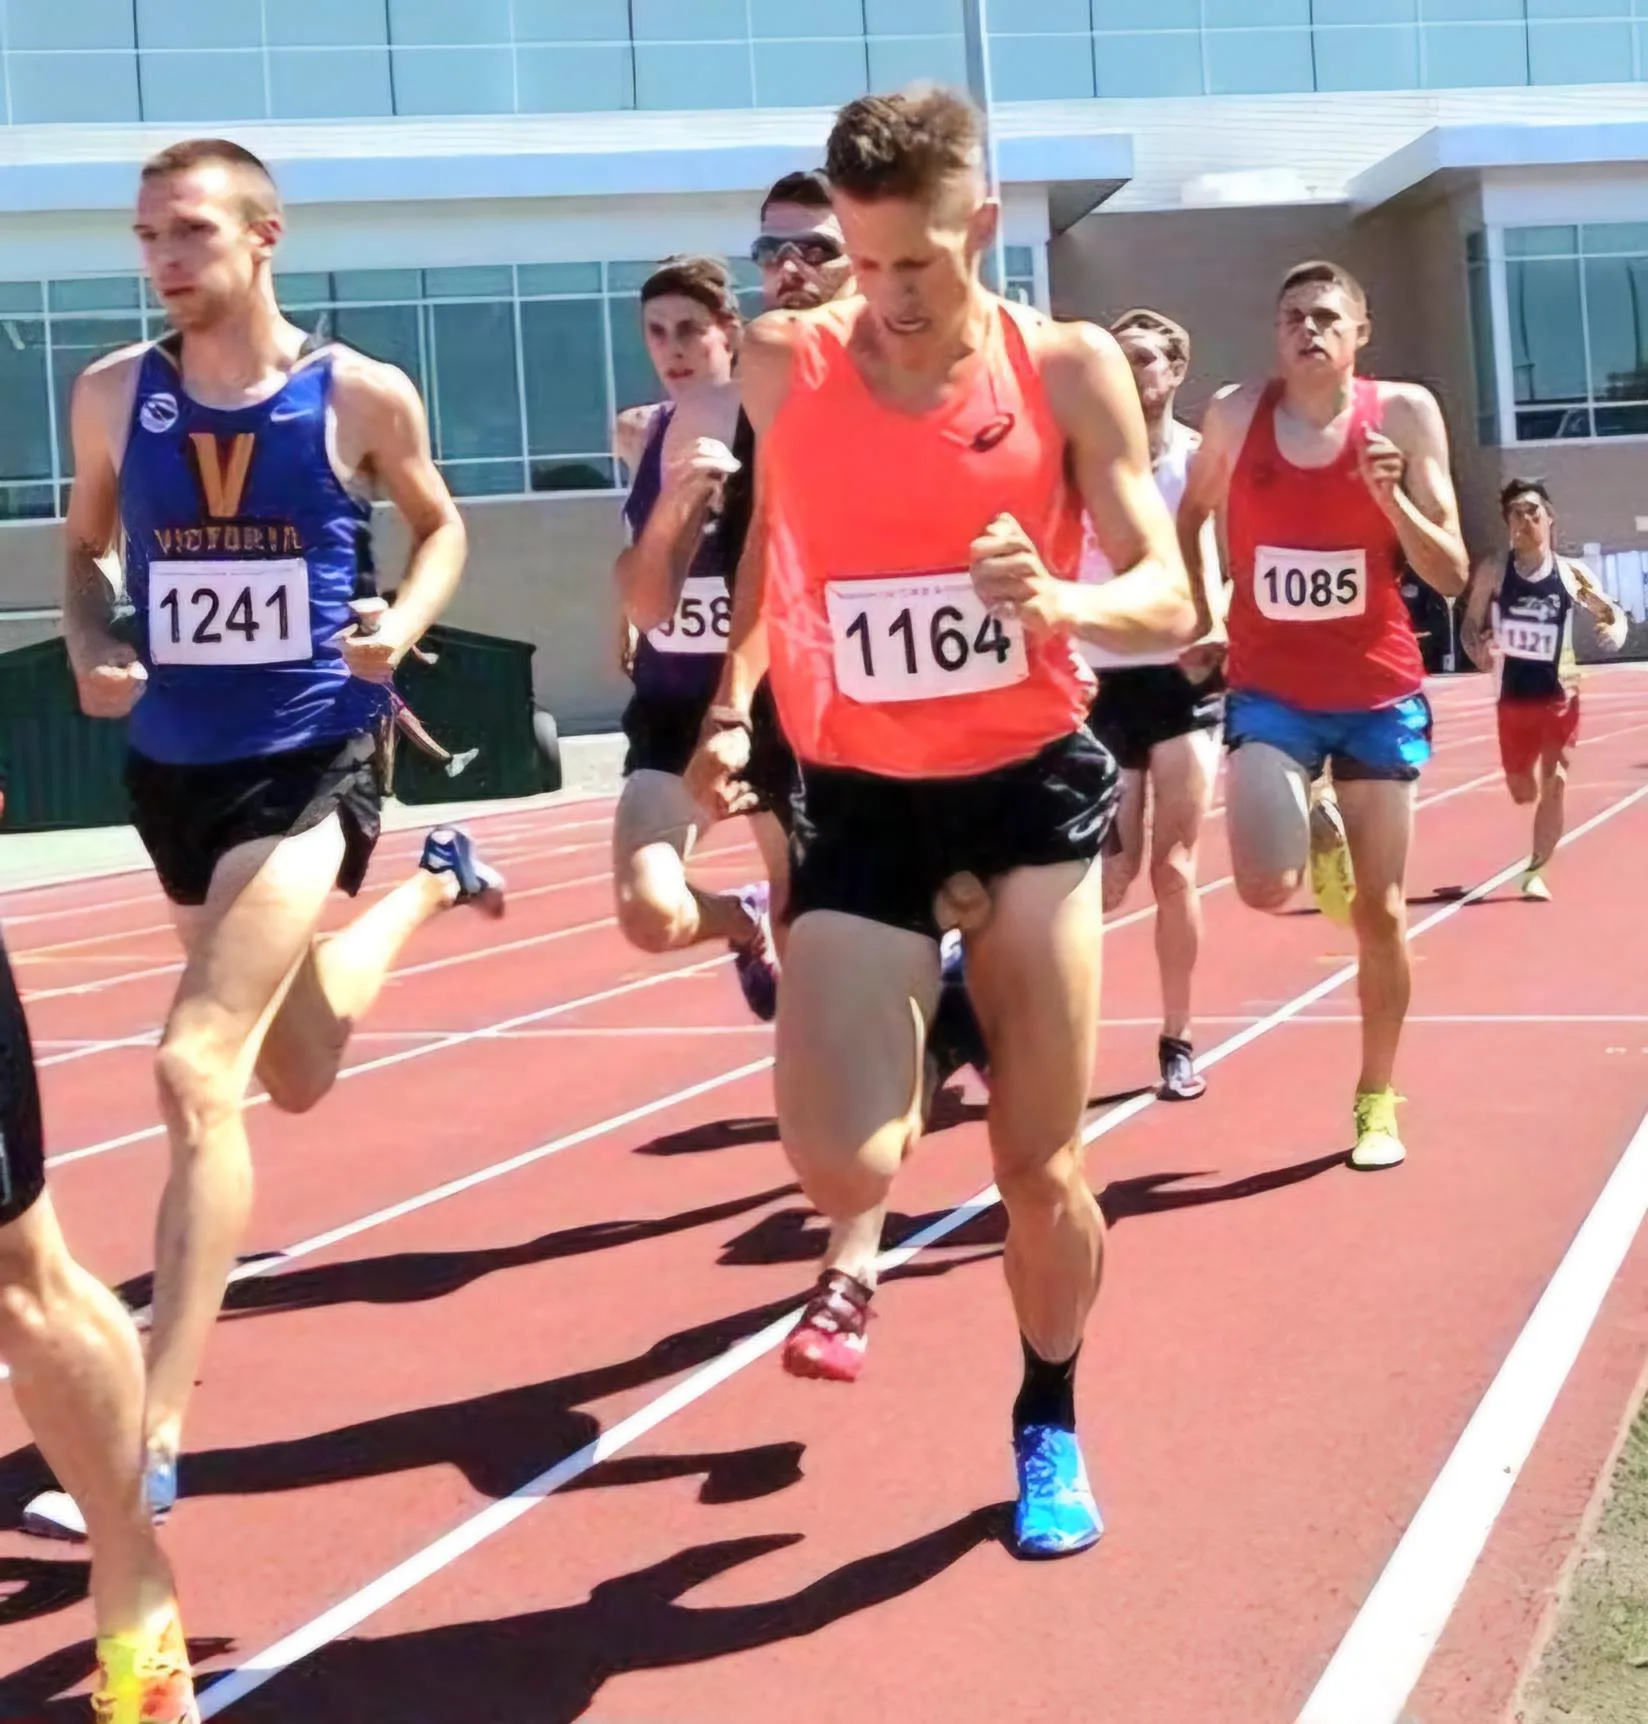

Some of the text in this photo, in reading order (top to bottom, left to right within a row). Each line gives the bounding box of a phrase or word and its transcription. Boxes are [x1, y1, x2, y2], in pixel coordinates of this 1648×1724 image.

[188, 432, 256, 518] V
[154, 526, 302, 554] VICTORIA
[160, 585, 290, 644] 1241
[1264, 566, 1358, 607] 1085
[846, 605, 1011, 677] 1164
